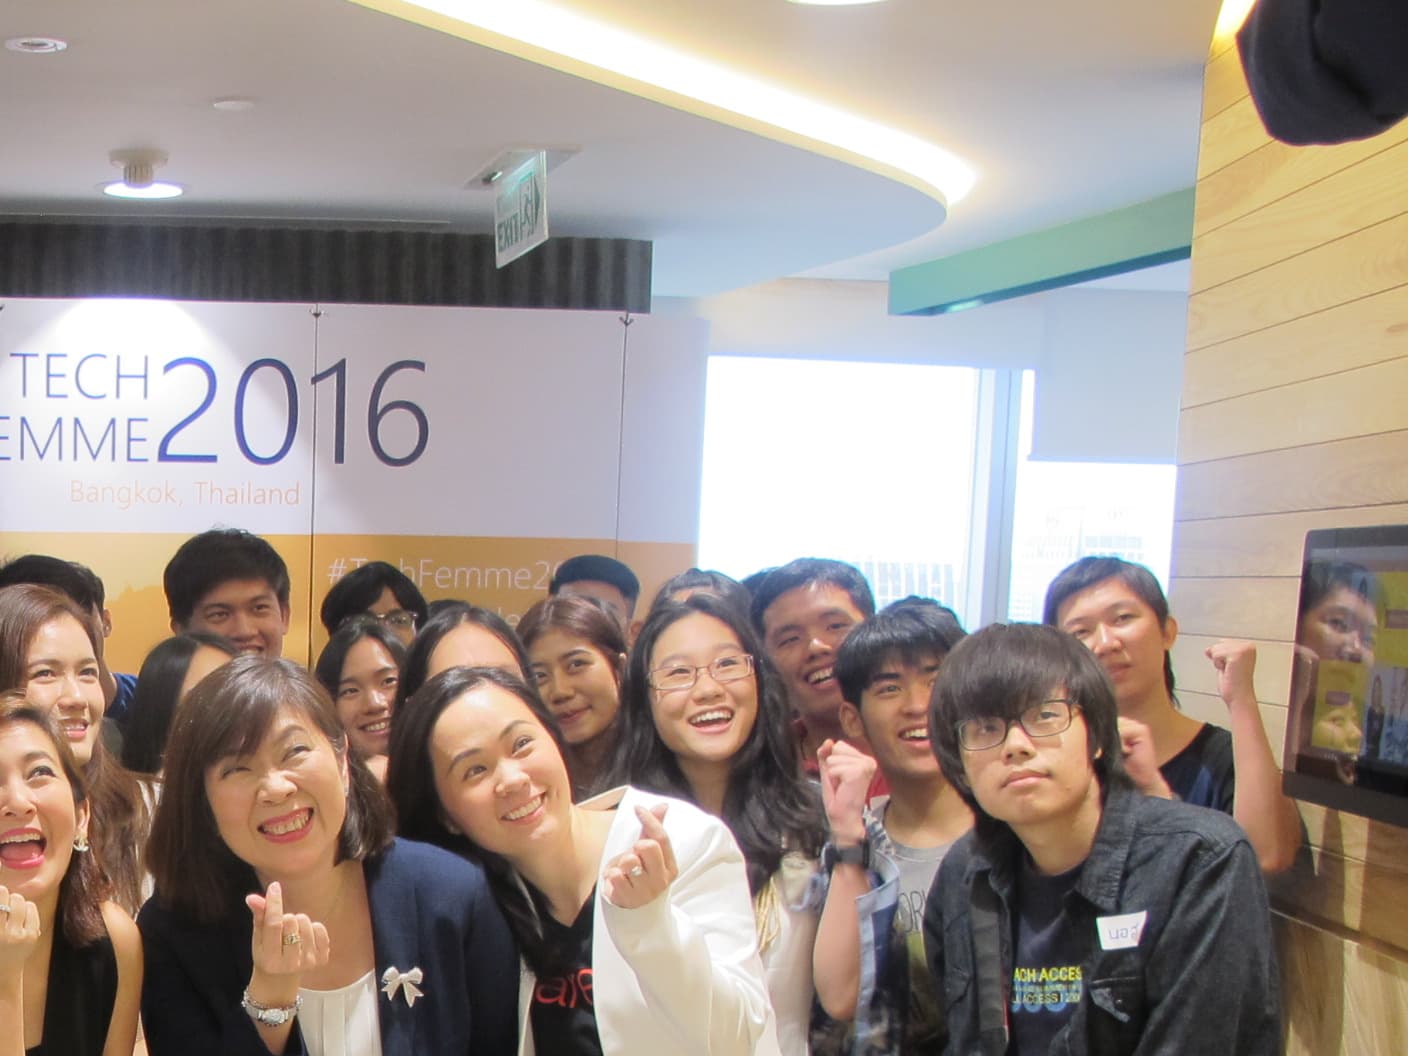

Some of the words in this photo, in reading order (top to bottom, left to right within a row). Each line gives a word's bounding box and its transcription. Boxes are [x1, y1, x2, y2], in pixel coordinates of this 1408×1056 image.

[496, 211, 522, 253] EXIT
[9, 353, 148, 400] TECH
[157, 356, 430, 467] 2016
[70, 480, 185, 510] Bangkok,
[194, 482, 301, 506] Thailand
